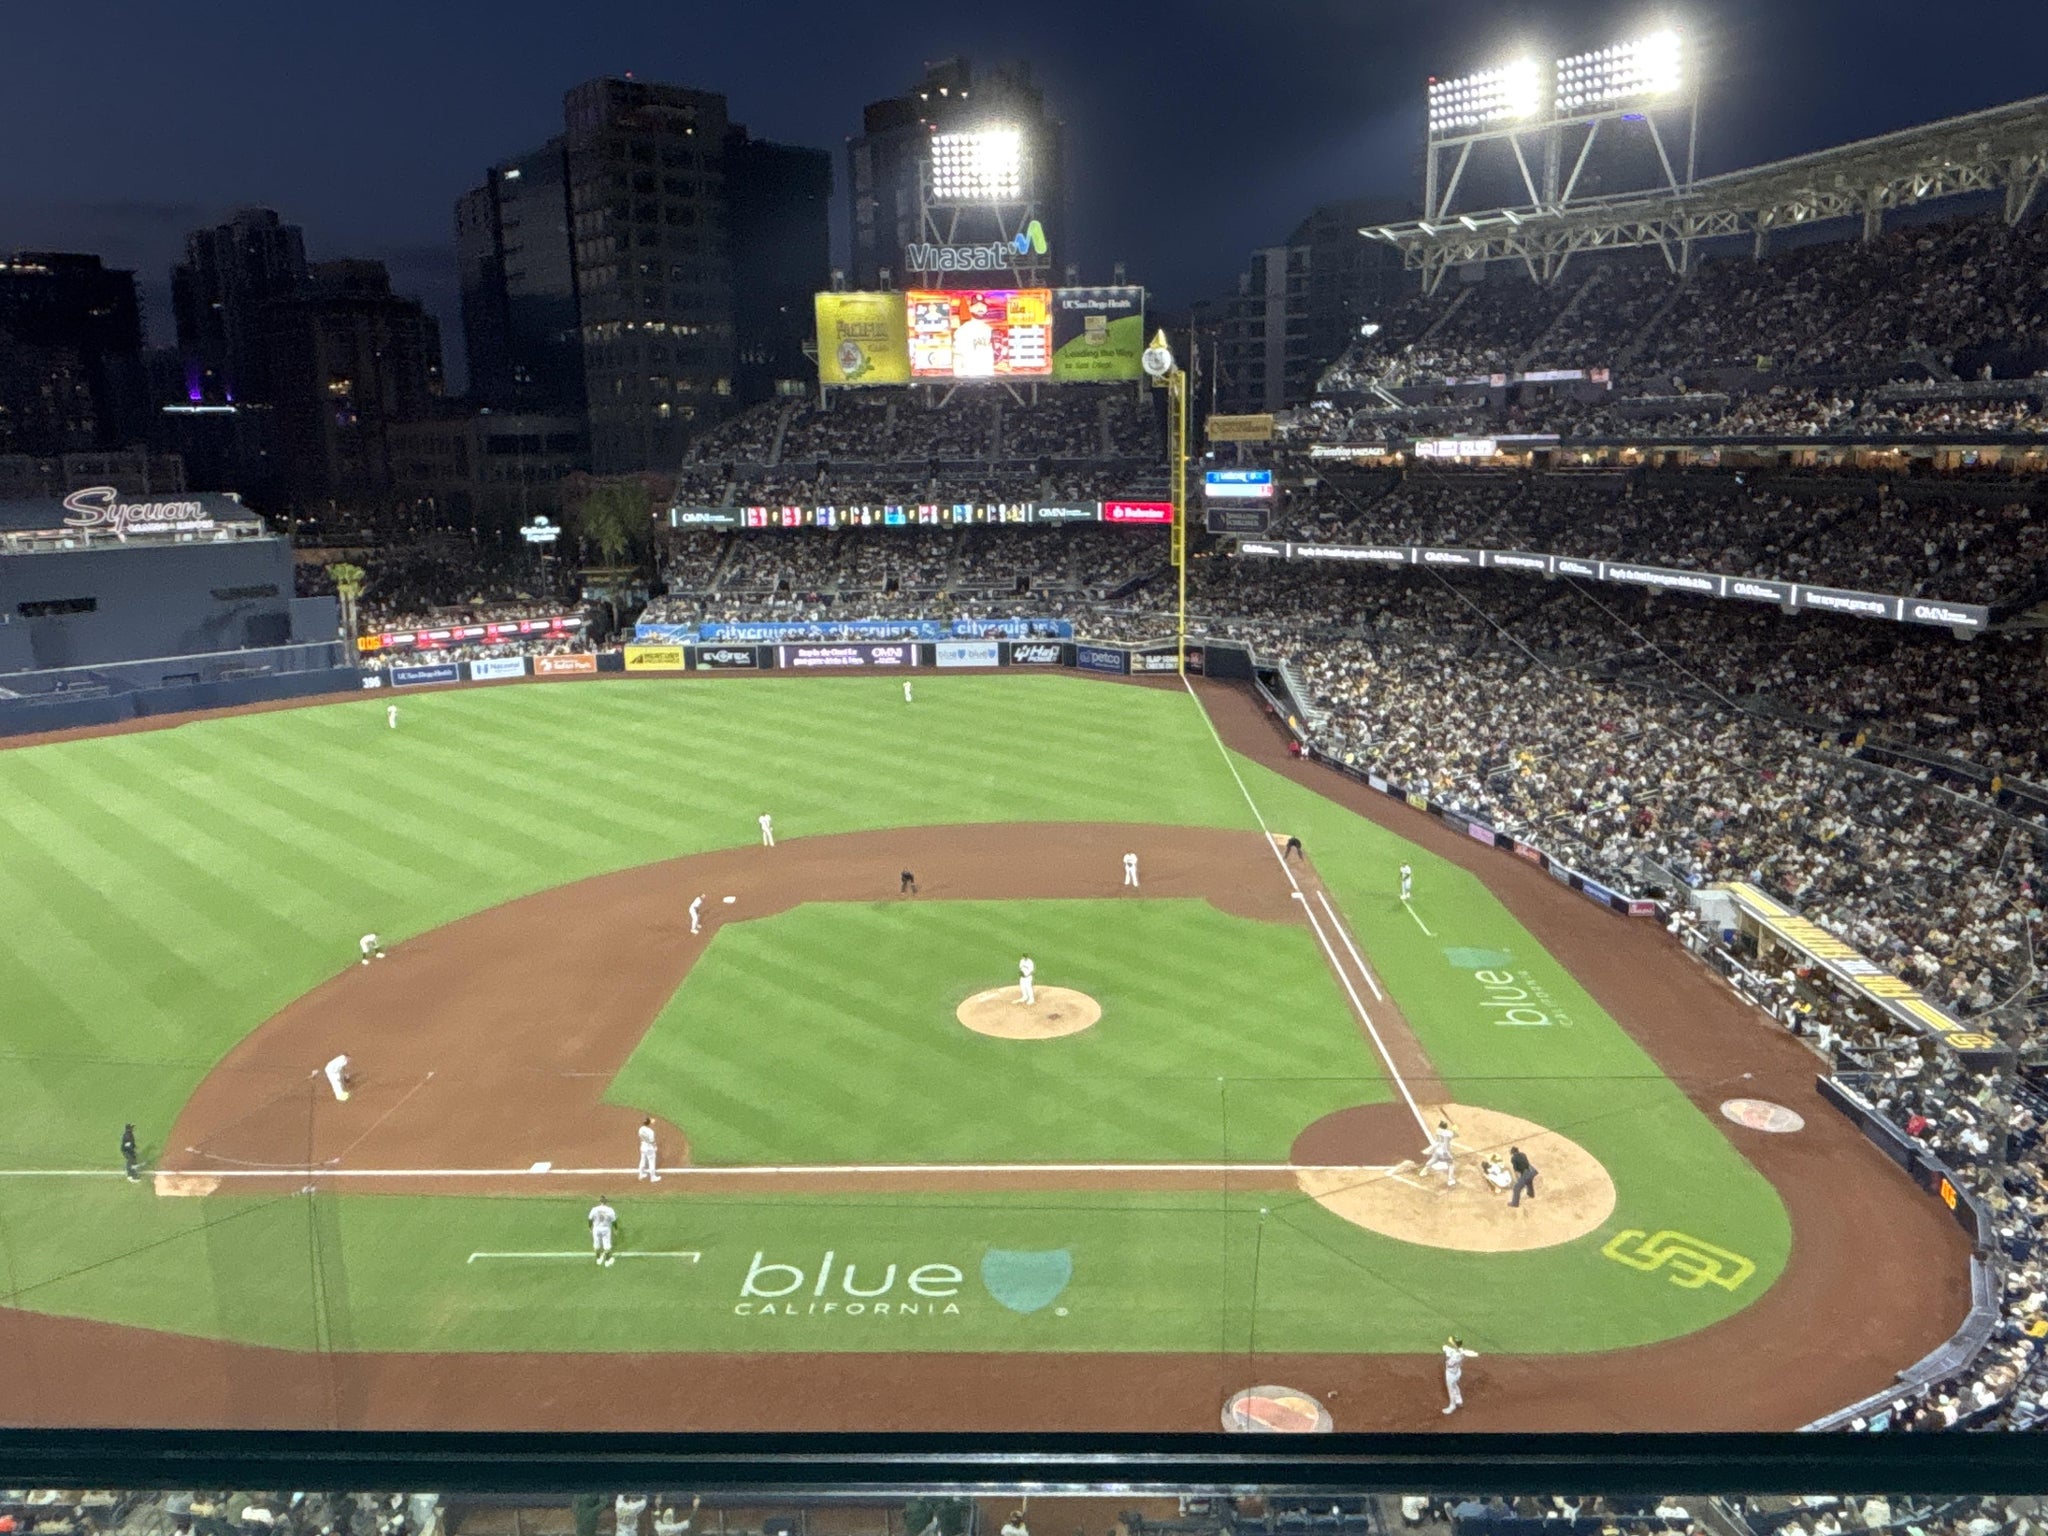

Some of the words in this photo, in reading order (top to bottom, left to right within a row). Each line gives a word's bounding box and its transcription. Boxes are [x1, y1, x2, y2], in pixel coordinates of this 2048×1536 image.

[908, 242, 1007, 270] Viasat
[1108, 300, 1131, 308] Health
[63, 486, 207, 531] Sycuan
[1092, 653, 1120, 664] petco
[363, 676, 380, 688] 396
[1475, 970, 1553, 1026] blue
[740, 1251, 963, 1298] blue
[734, 1302, 961, 1316] CALIFORNIA
